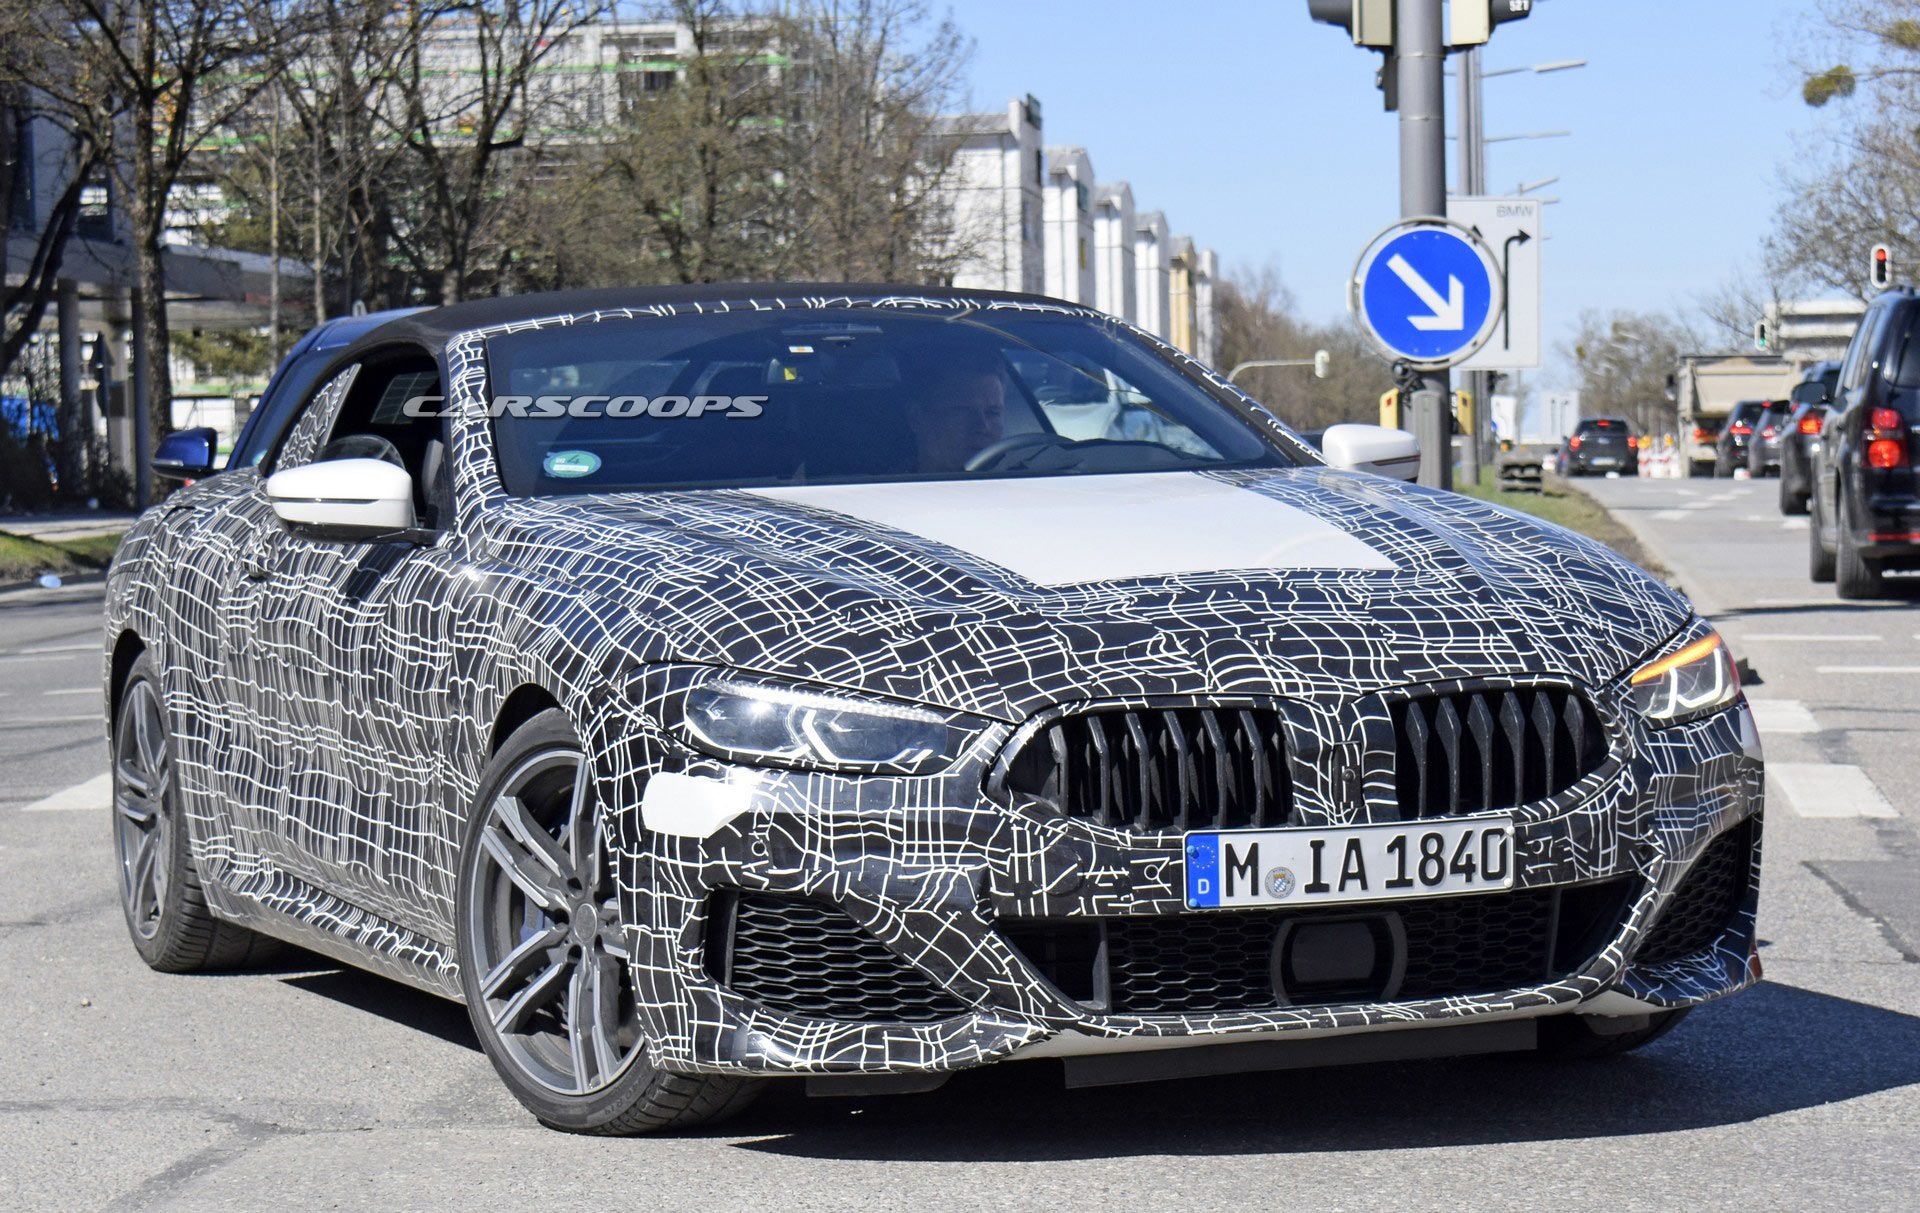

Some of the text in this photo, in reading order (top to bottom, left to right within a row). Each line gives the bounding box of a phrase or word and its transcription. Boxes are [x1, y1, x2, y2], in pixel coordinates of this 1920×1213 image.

[1496, 205, 1534, 217] BMW
[1225, 842, 1259, 897] M
[1304, 838, 1369, 893] IA
[1385, 828, 1508, 889] 1840
[1197, 878, 1210, 895] D
